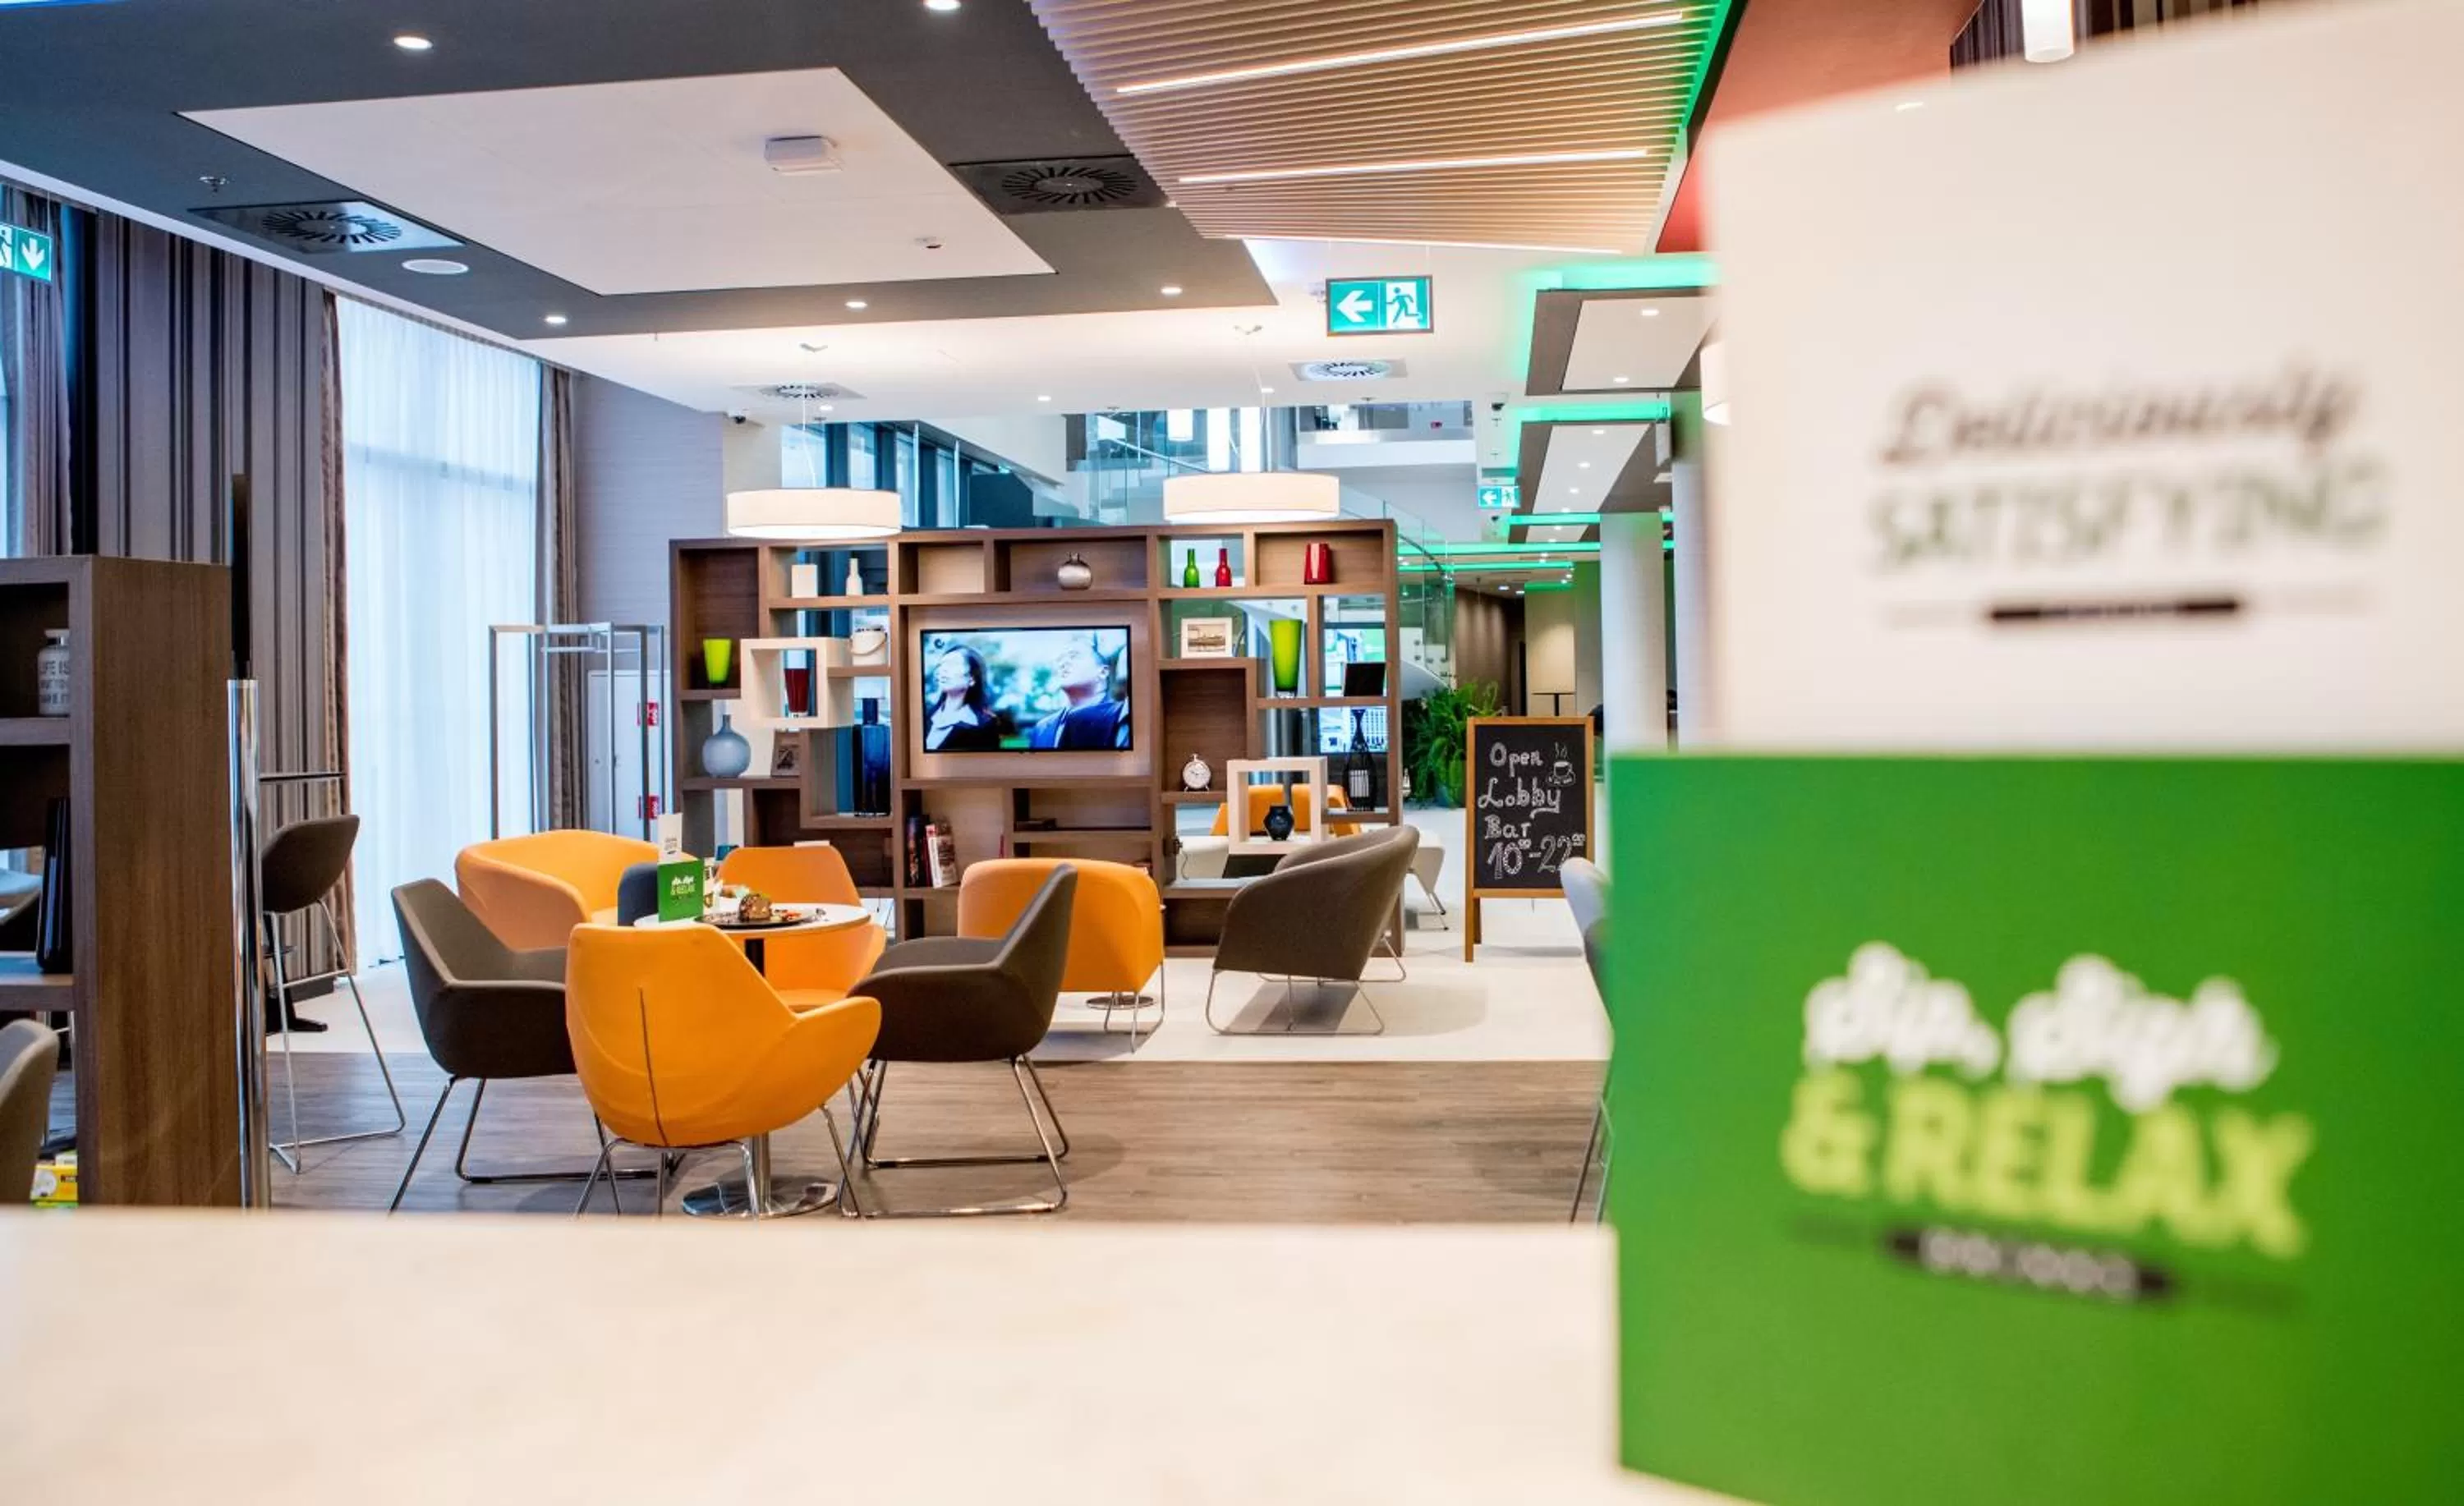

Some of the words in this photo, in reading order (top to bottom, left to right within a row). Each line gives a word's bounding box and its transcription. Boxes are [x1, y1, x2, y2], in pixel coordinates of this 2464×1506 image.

[1490, 742, 1543, 778] Open
[1478, 777, 1561, 819] Lobby
[1485, 814, 1532, 839] Bar
[1781, 1068, 1876, 1199] &
[1882, 1076, 2315, 1258] RELAX
